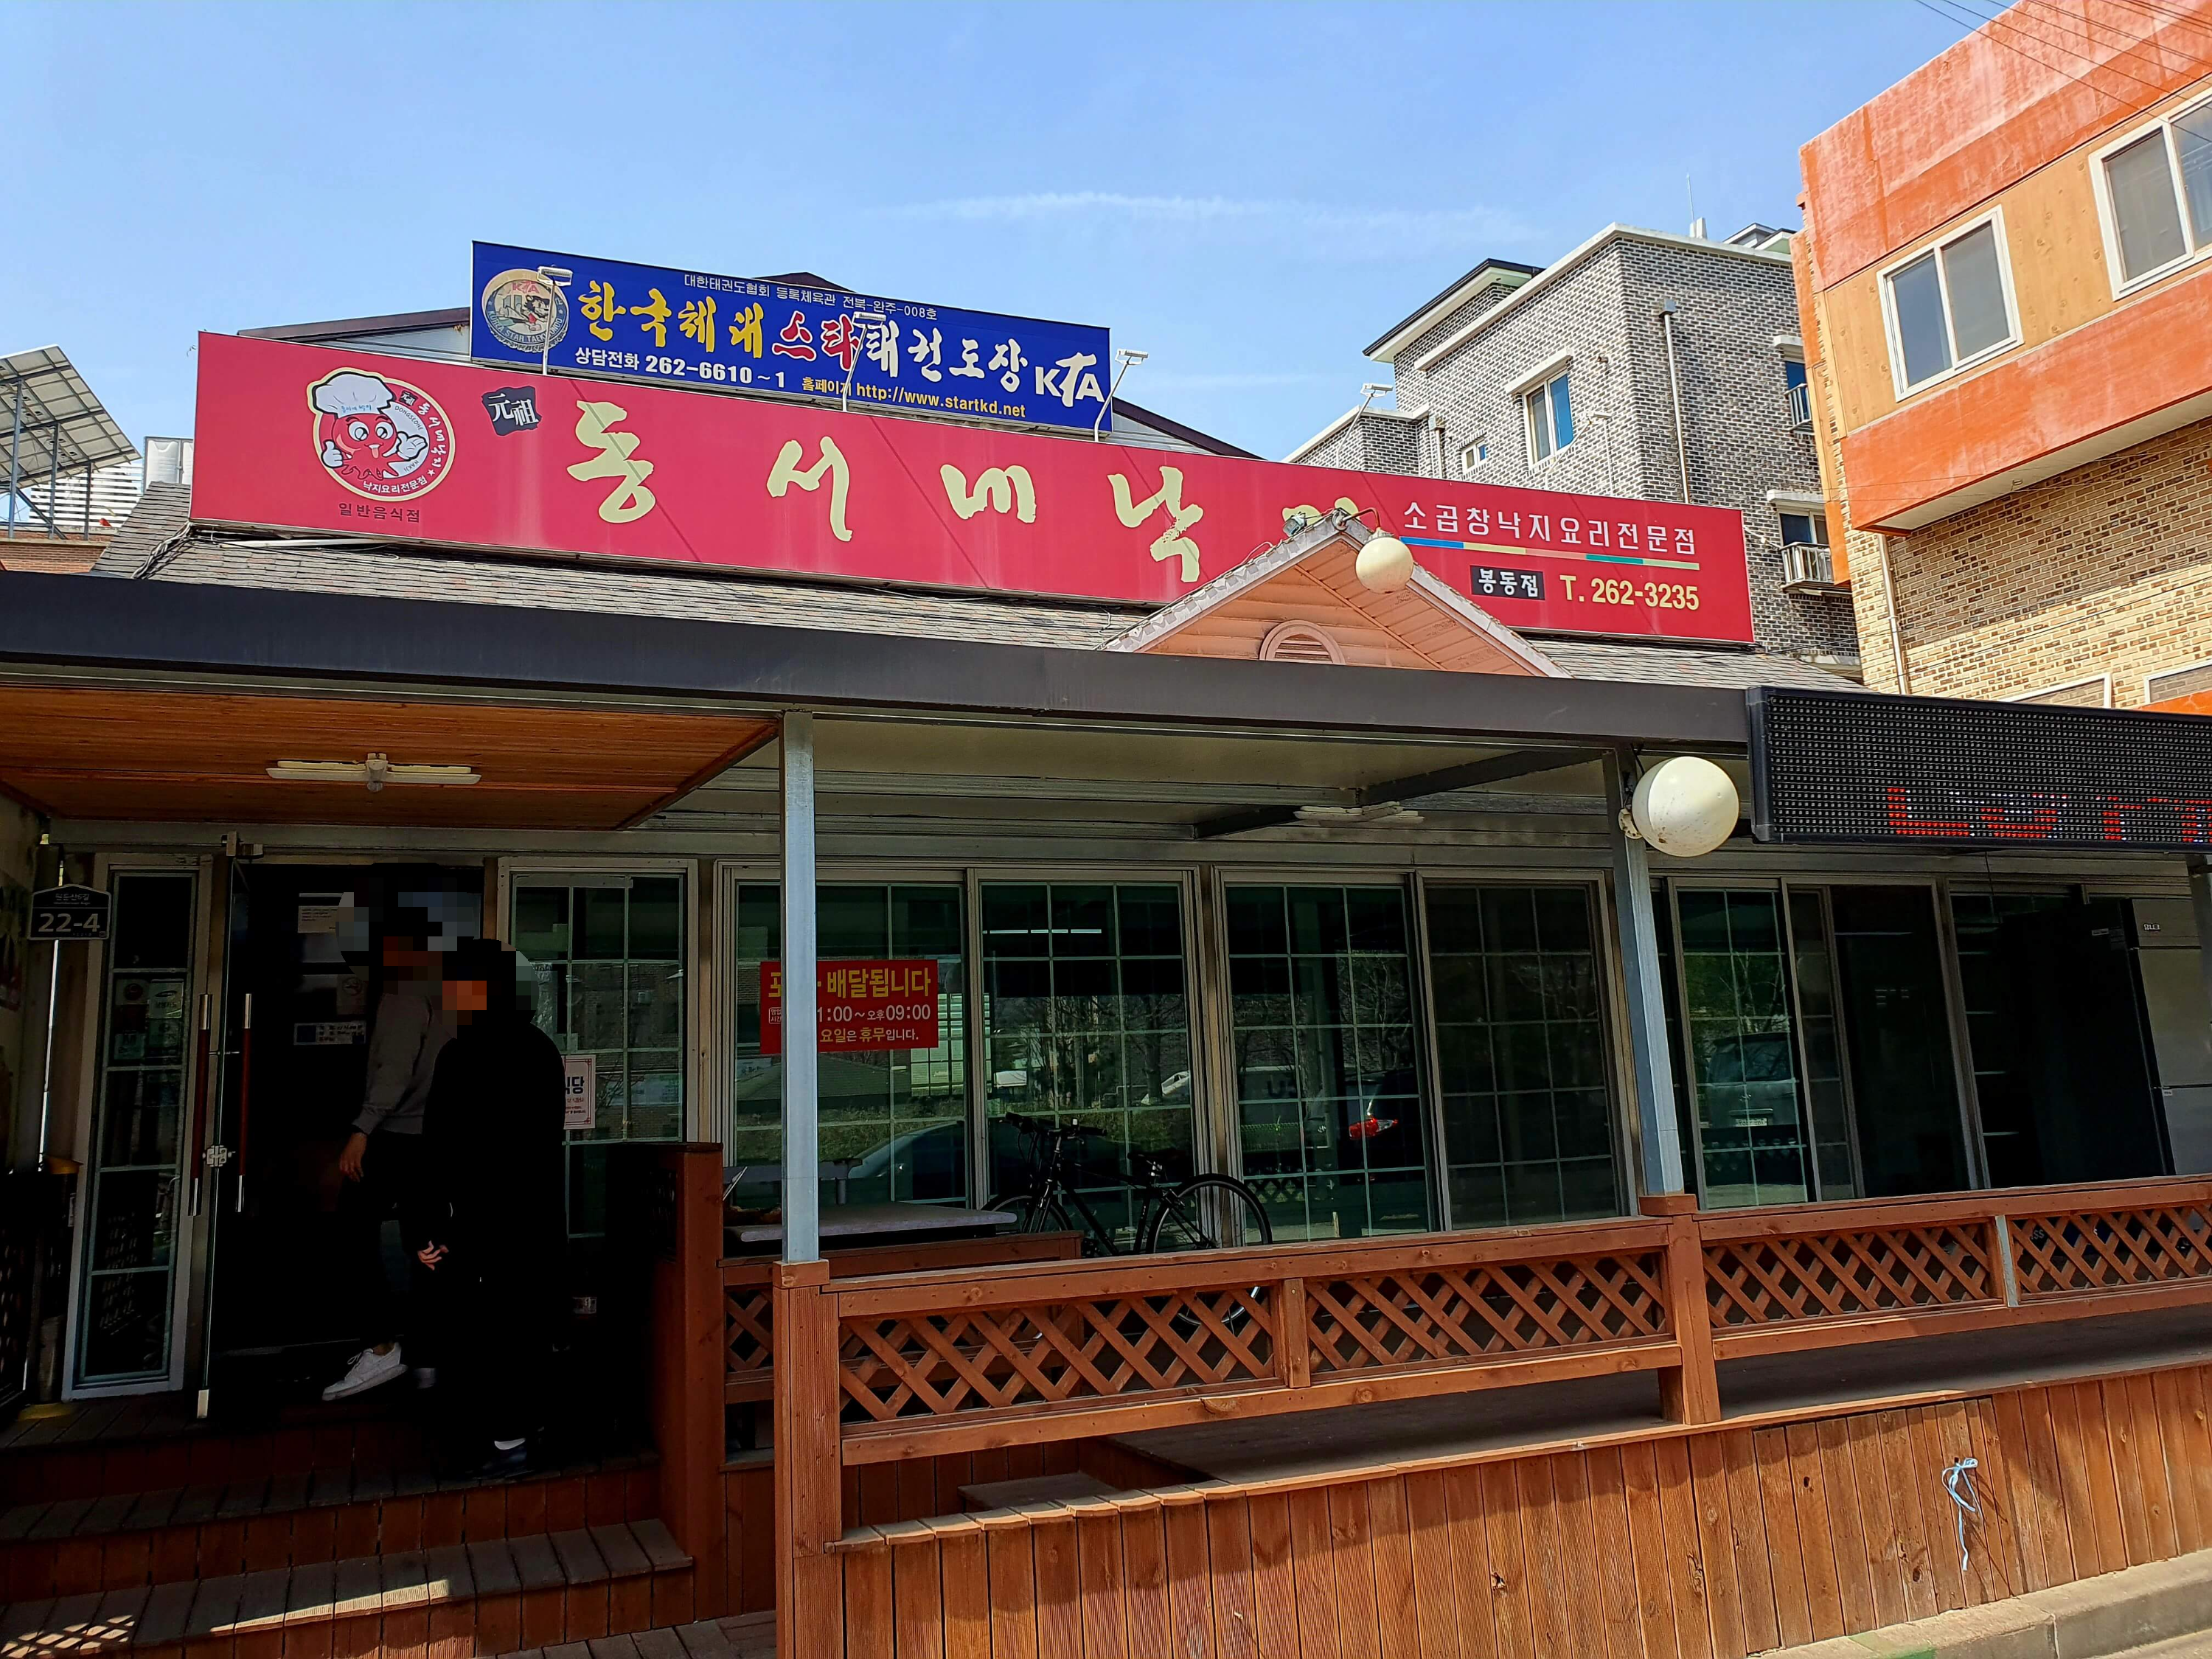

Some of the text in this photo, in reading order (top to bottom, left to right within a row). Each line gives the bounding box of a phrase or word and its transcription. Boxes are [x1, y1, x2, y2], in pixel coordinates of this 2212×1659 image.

[684, 274, 937, 321] 대한태권도협회 등록체육관 전북-완주-008호
[575, 348, 640, 371] 상담전화
[1035, 352, 1105, 407] KTA
[488, 393, 538, 426] 元祖
[802, 377, 1026, 418] 홈페이지 http://www.startkd.net
[363, 476, 428, 494] 낙지요리전문점
[339, 502, 420, 523] 일반음식점
[1403, 501, 1695, 555] 소곱창낙지요리전문점
[1478, 568, 1539, 597] 봉동점
[1591, 577, 1700, 611] 262-3235
[38, 913, 101, 933] 22-4
[859, 1027, 919, 1043] 휴무입니다.
